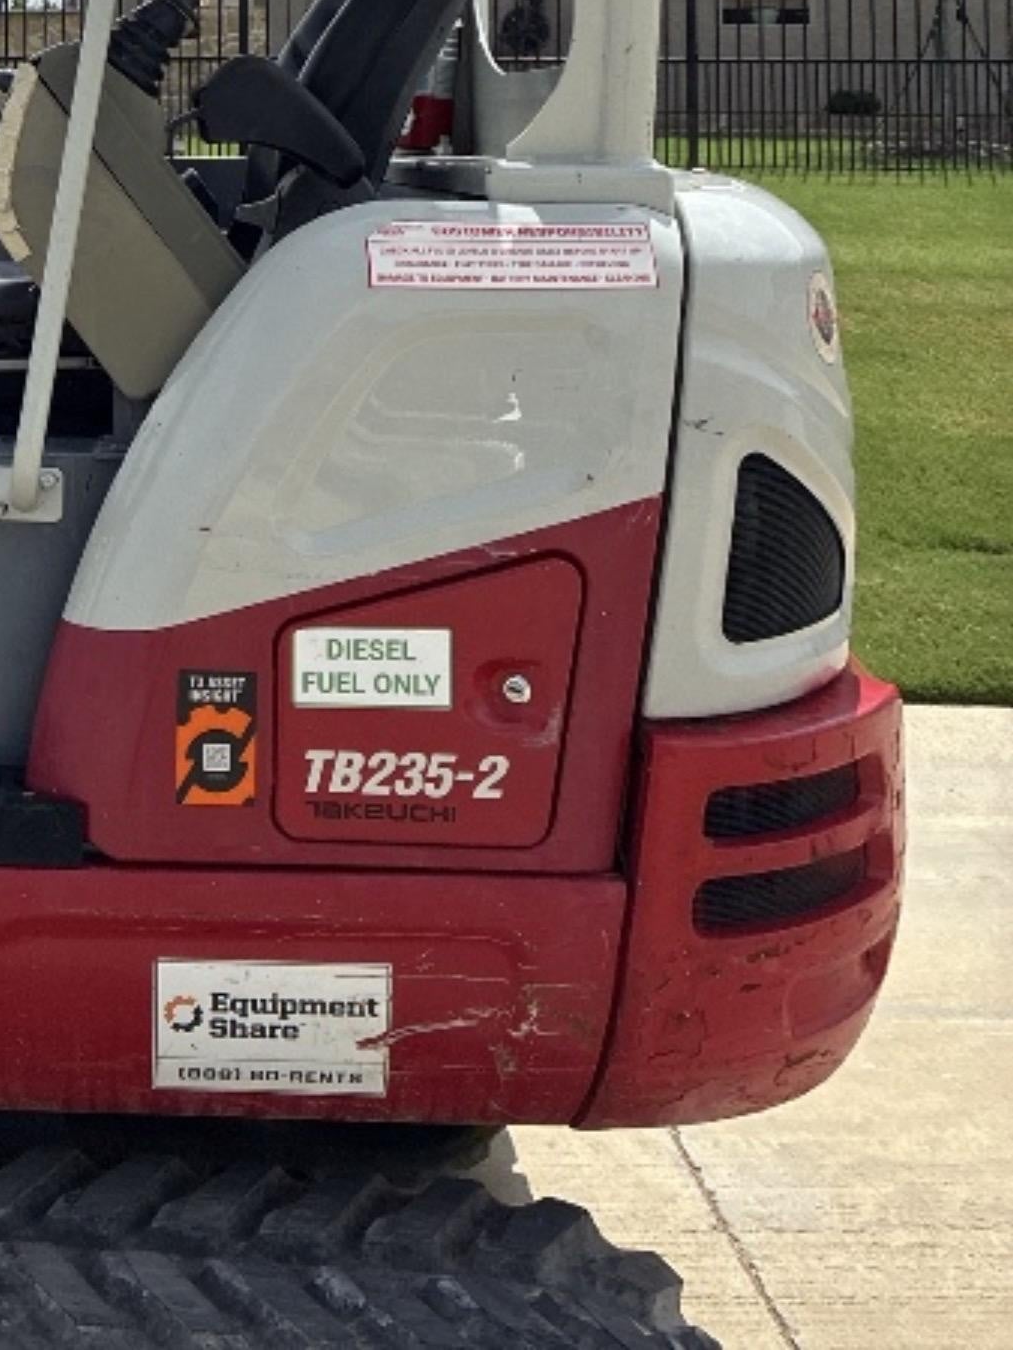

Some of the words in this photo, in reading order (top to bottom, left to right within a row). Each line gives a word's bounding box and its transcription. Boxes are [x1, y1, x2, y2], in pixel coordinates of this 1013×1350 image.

[326, 638, 417, 661] DIESEL
[301, 671, 366, 694] FUEL
[373, 673, 441, 696] ONLY
[303, 749, 511, 800] TB235-2
[209, 992, 379, 1019] Equipment
[209, 1018, 300, 1039] Share
